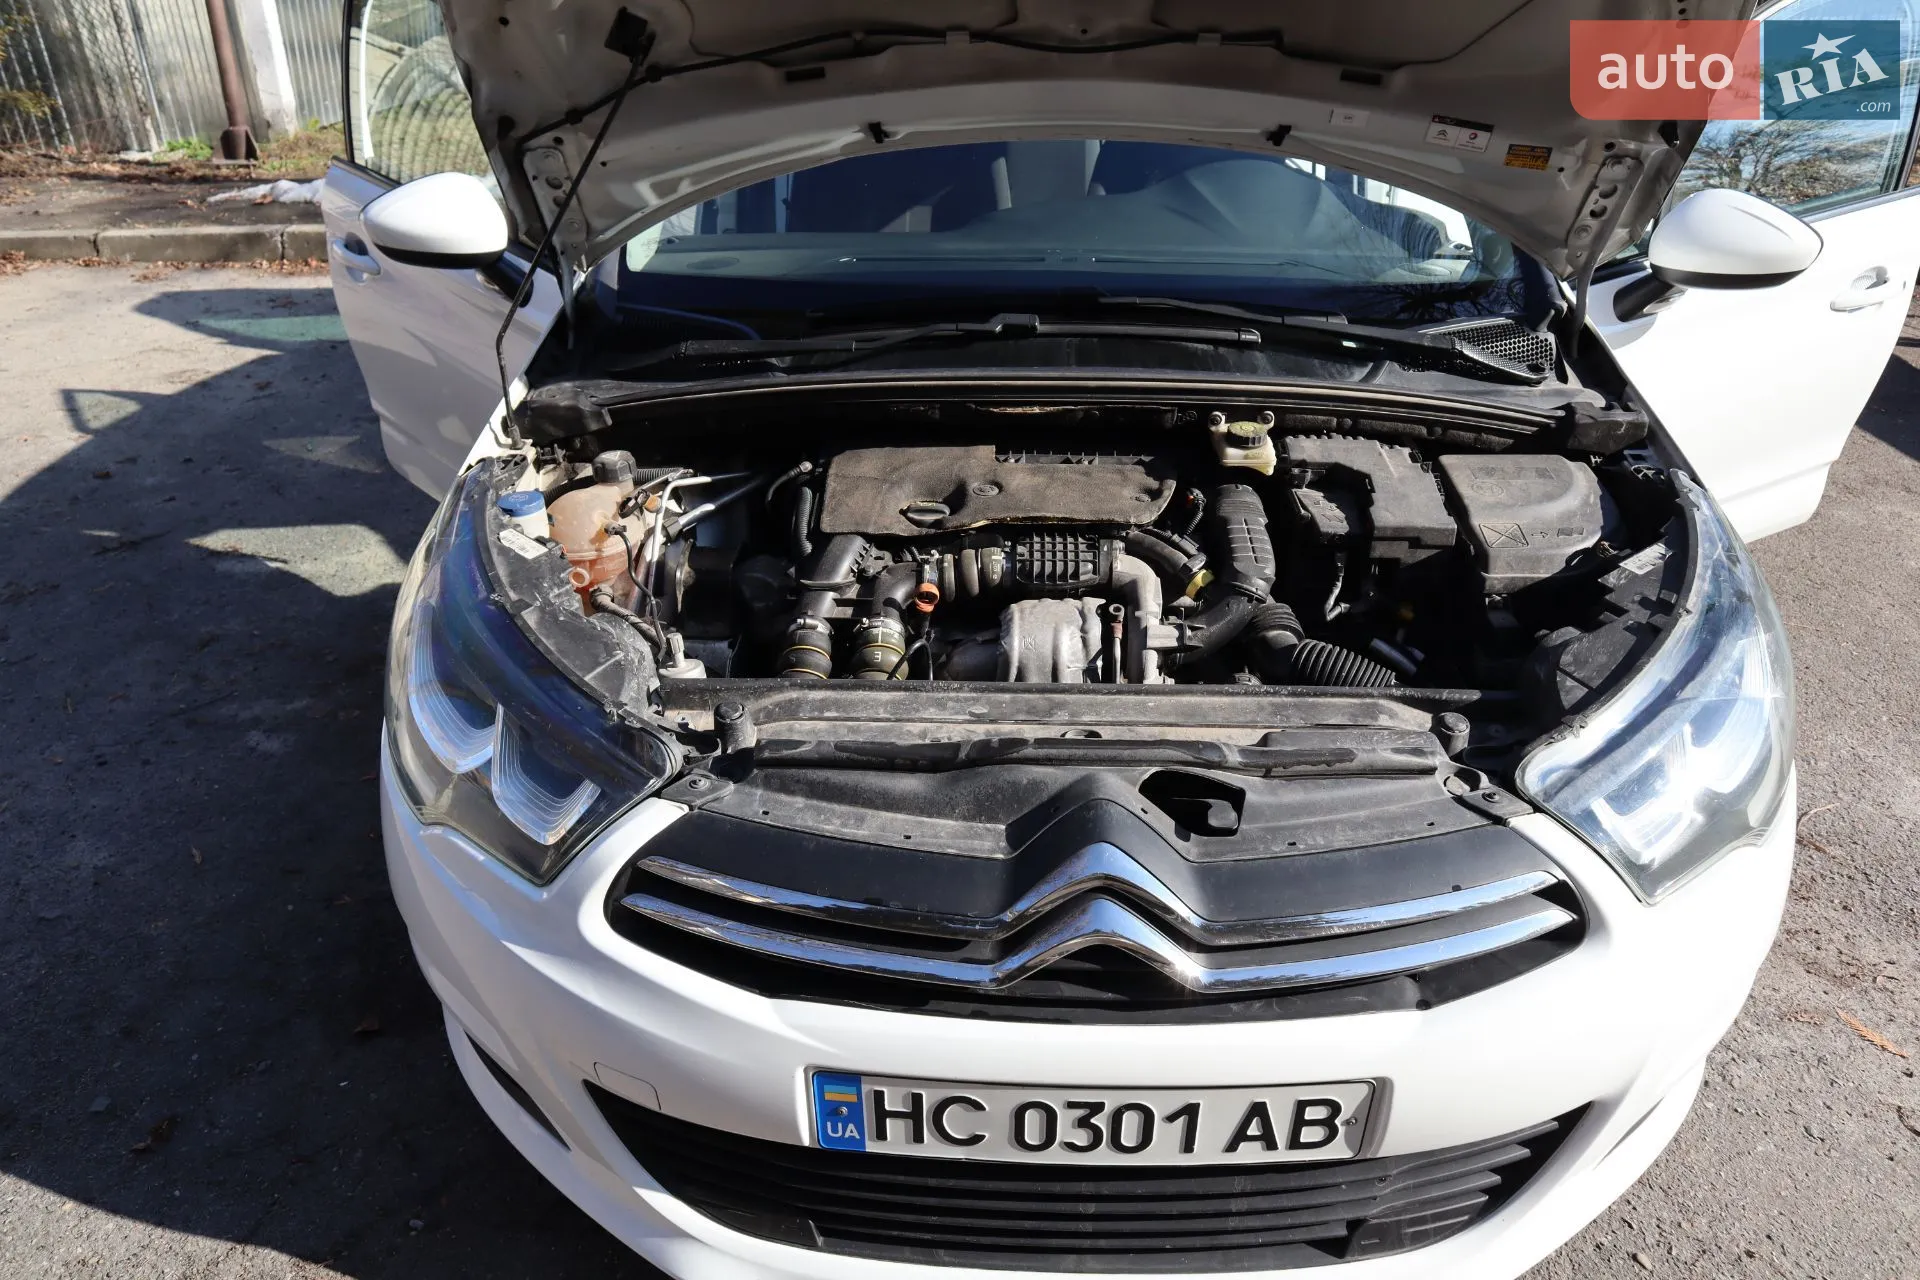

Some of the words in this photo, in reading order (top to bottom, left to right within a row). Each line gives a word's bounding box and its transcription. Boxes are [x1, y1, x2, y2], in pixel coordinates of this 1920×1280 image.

[826, 1121, 861, 1139] UA
[874, 1089, 987, 1147] HC
[1015, 1100, 1201, 1154] 0301
[1223, 1098, 1343, 1152] AB
